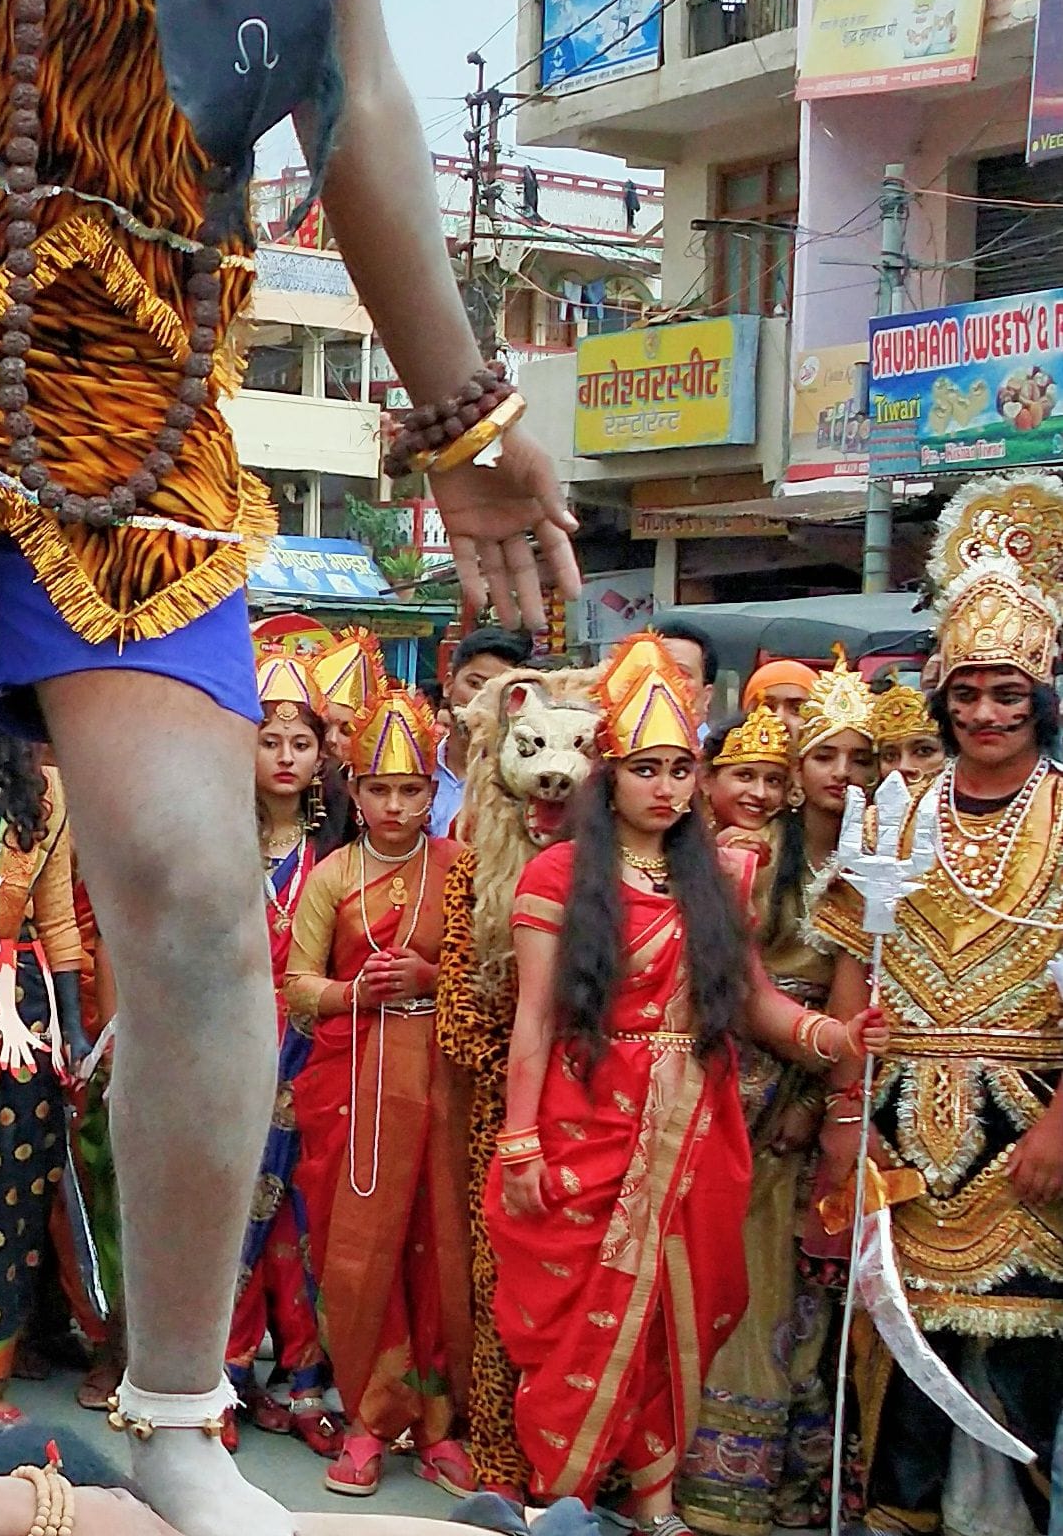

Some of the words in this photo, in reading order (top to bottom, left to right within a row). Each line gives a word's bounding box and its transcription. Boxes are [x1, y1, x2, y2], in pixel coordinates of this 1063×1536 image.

[873, 318, 959, 378] SHUBHAM
[963, 309, 1031, 364] SWEETS
[1037, 305, 1049, 351] &
[874, 394, 921, 423] Tiwari
